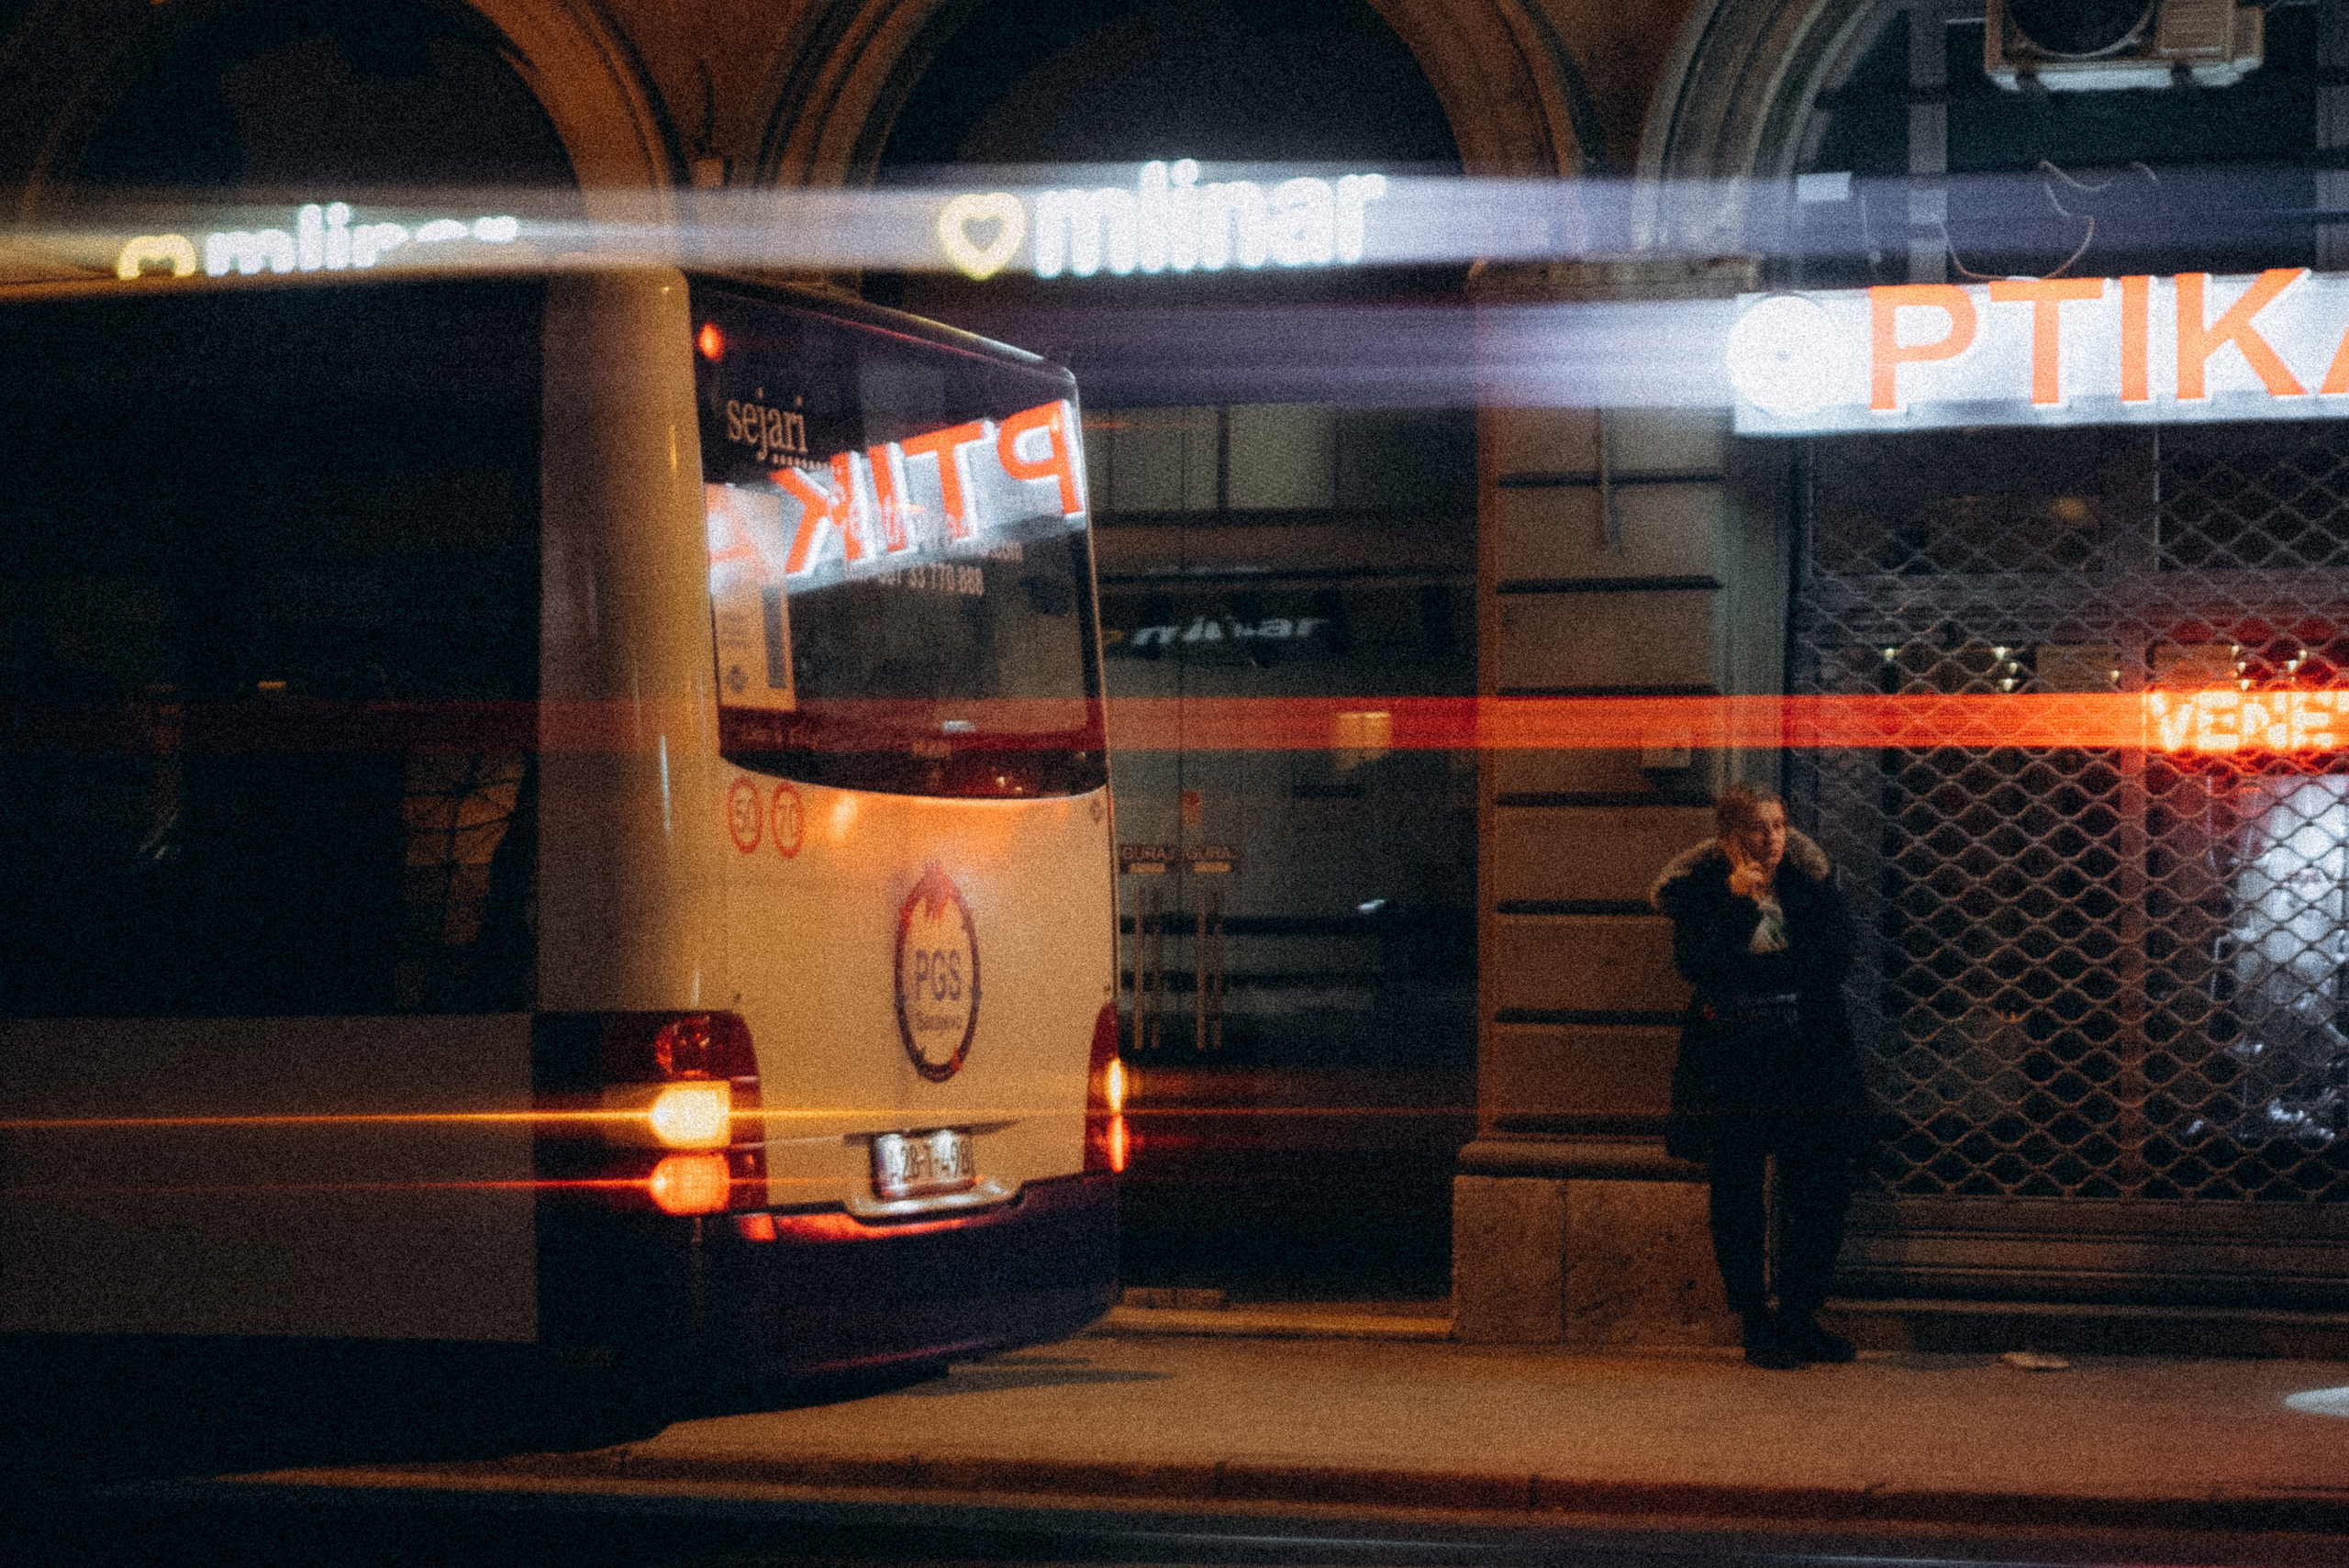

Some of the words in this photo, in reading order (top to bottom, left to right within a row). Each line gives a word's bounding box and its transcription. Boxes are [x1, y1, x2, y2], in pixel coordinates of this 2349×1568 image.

[1034, 158, 1387, 278] mlinar
[726, 386, 809, 461] sejari
[2149, 690, 2349, 751] VENE
[916, 949, 963, 1003] PGS
